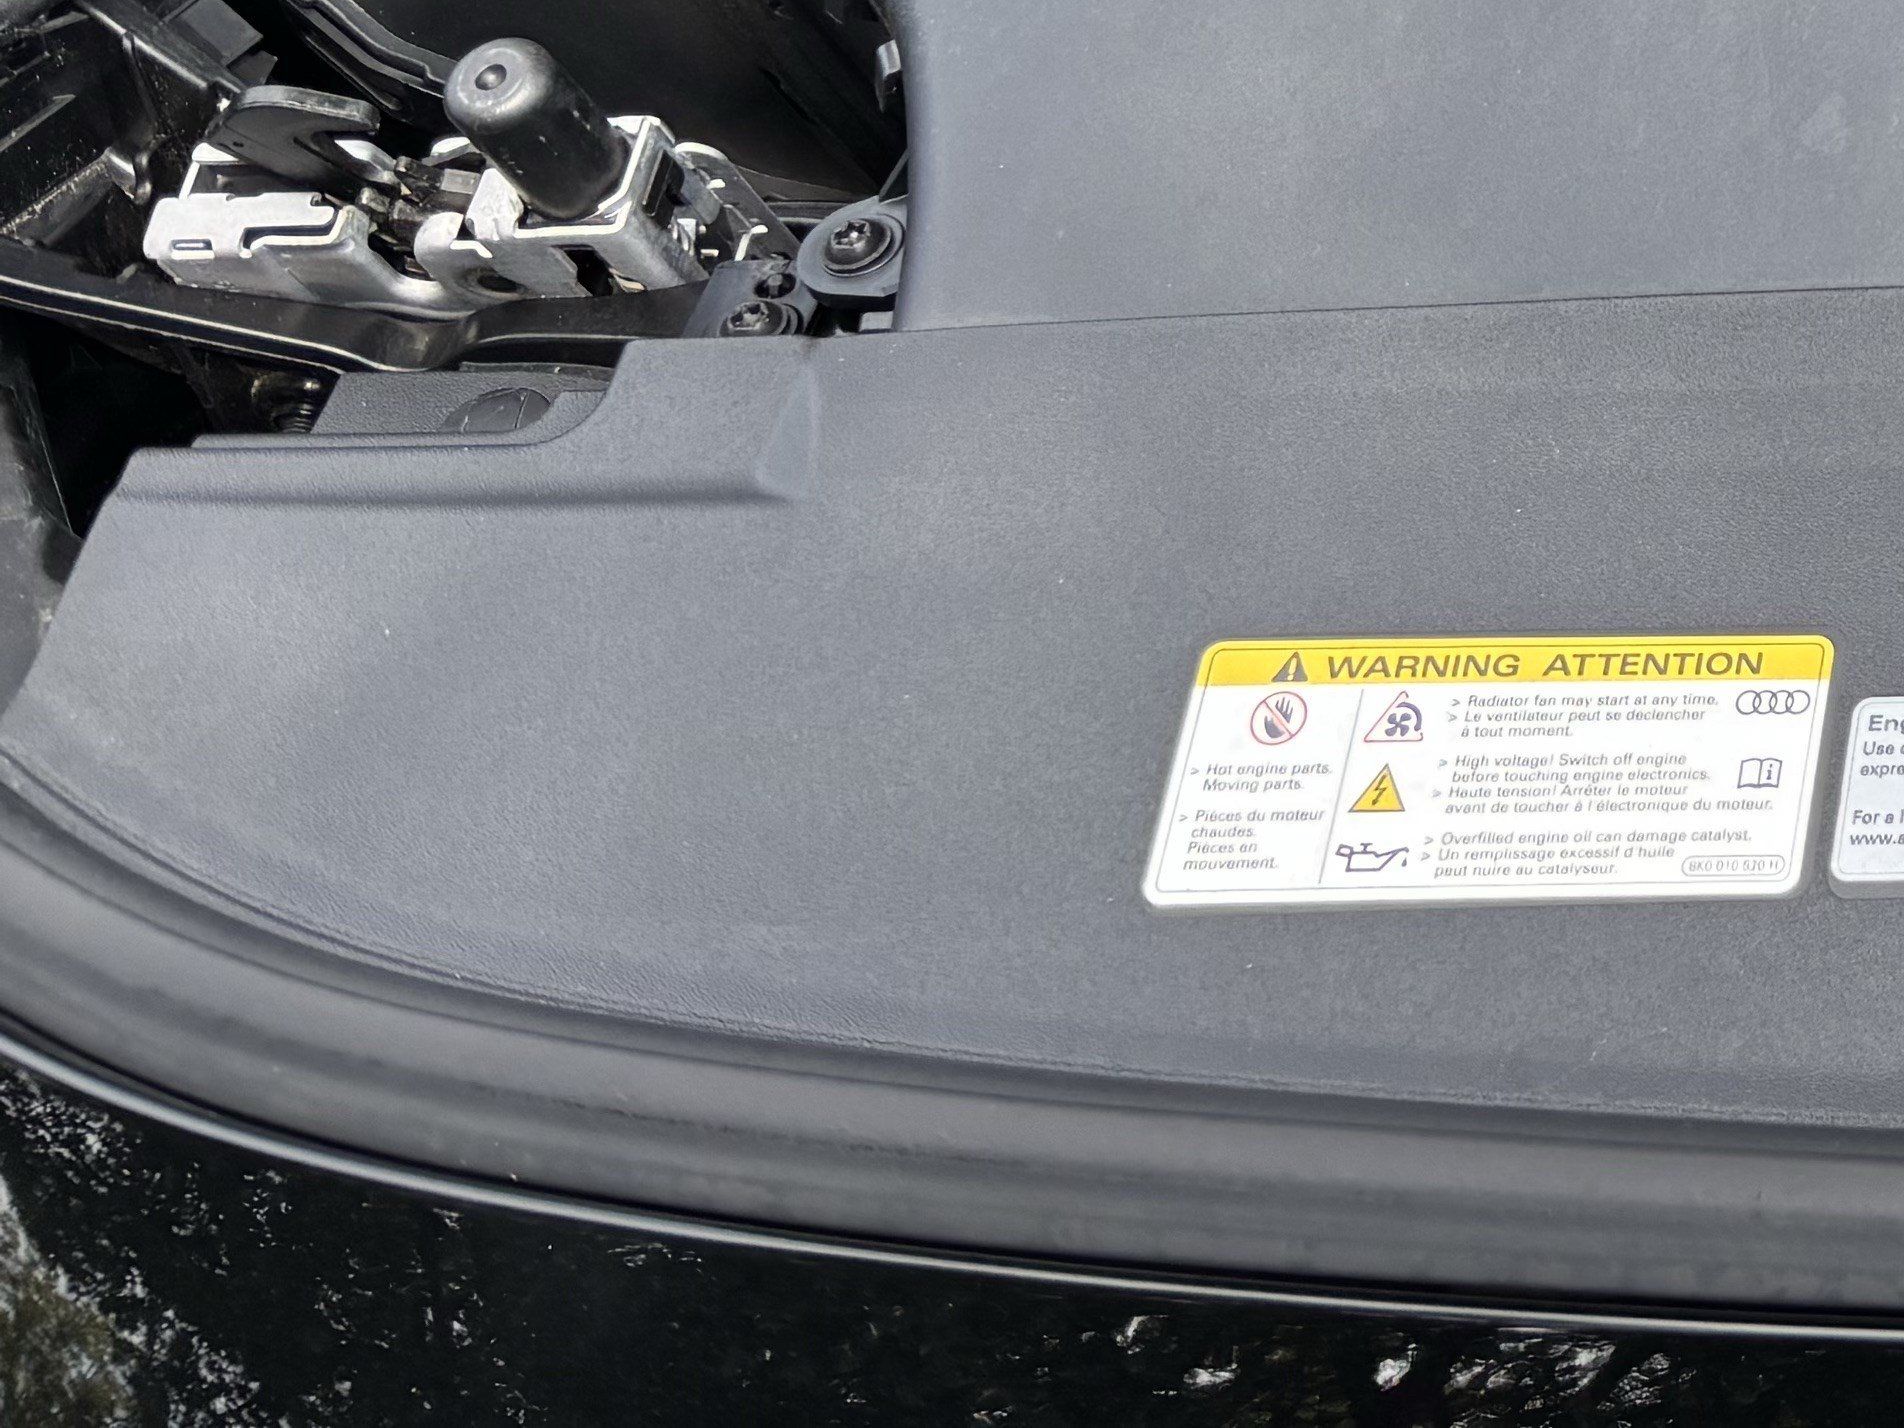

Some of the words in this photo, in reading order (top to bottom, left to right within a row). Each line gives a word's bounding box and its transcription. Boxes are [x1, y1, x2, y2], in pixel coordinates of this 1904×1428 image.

[1327, 652, 1522, 679] WARNING
[1541, 650, 1764, 677] ATTENTION
[1468, 695, 1529, 707] Radiator
[1534, 694, 1556, 707] fan
[1562, 696, 1592, 708] may
[1597, 694, 1629, 706] start
[1634, 696, 1647, 706] at
[1652, 696, 1678, 707] any
[1464, 711, 1481, 722] Le
[1487, 710, 1563, 722] ventilateur
[1568, 710, 1601, 723] peut
[1606, 712, 1622, 722] se
[1474, 726, 1503, 738] tout
[1863, 741, 1895, 756] Use
[1455, 755, 1489, 771] High
[1559, 754, 1608, 767] Switch
[1613, 753, 1634, 767] off
[1637, 754, 1687, 768] engine
[1207, 763, 1232, 776] Hot
[1237, 762, 1287, 778] engine
[1452, 770, 1499, 783] before
[1504, 770, 1569, 784] touching
[1573, 770, 1623, 784] engine
[1203, 778, 1259, 793] Moving
[1448, 785, 1491, 799] Haute
[1617, 783, 1629, 796] le
[1634, 785, 1688, 796] moteur
[1445, 803, 1486, 814] avant
[1490, 802, 1507, 813] de
[1513, 801, 1569, 813] toucher
[1693, 798, 1711, 810] du
[1247, 810, 1266, 822] du
[1270, 810, 1325, 822] moteur
[1852, 809, 1880, 825] For
[1884, 812, 1894, 824] a
[1441, 831, 1514, 846] Overfilled
[1518, 834, 1569, 847] engine
[1573, 831, 1593, 844] oil
[1596, 832, 1622, 843] can
[1626, 830, 1686, 844] damage
[1239, 843, 1258, 853] en
[1438, 848, 1459, 861] Un
[1464, 848, 1555, 863] remplissage
[1559, 846, 1621, 860] excessif
[1434, 865, 1468, 879] peut
[1472, 864, 1511, 877] nuire
[1516, 865, 1533, 876] au
